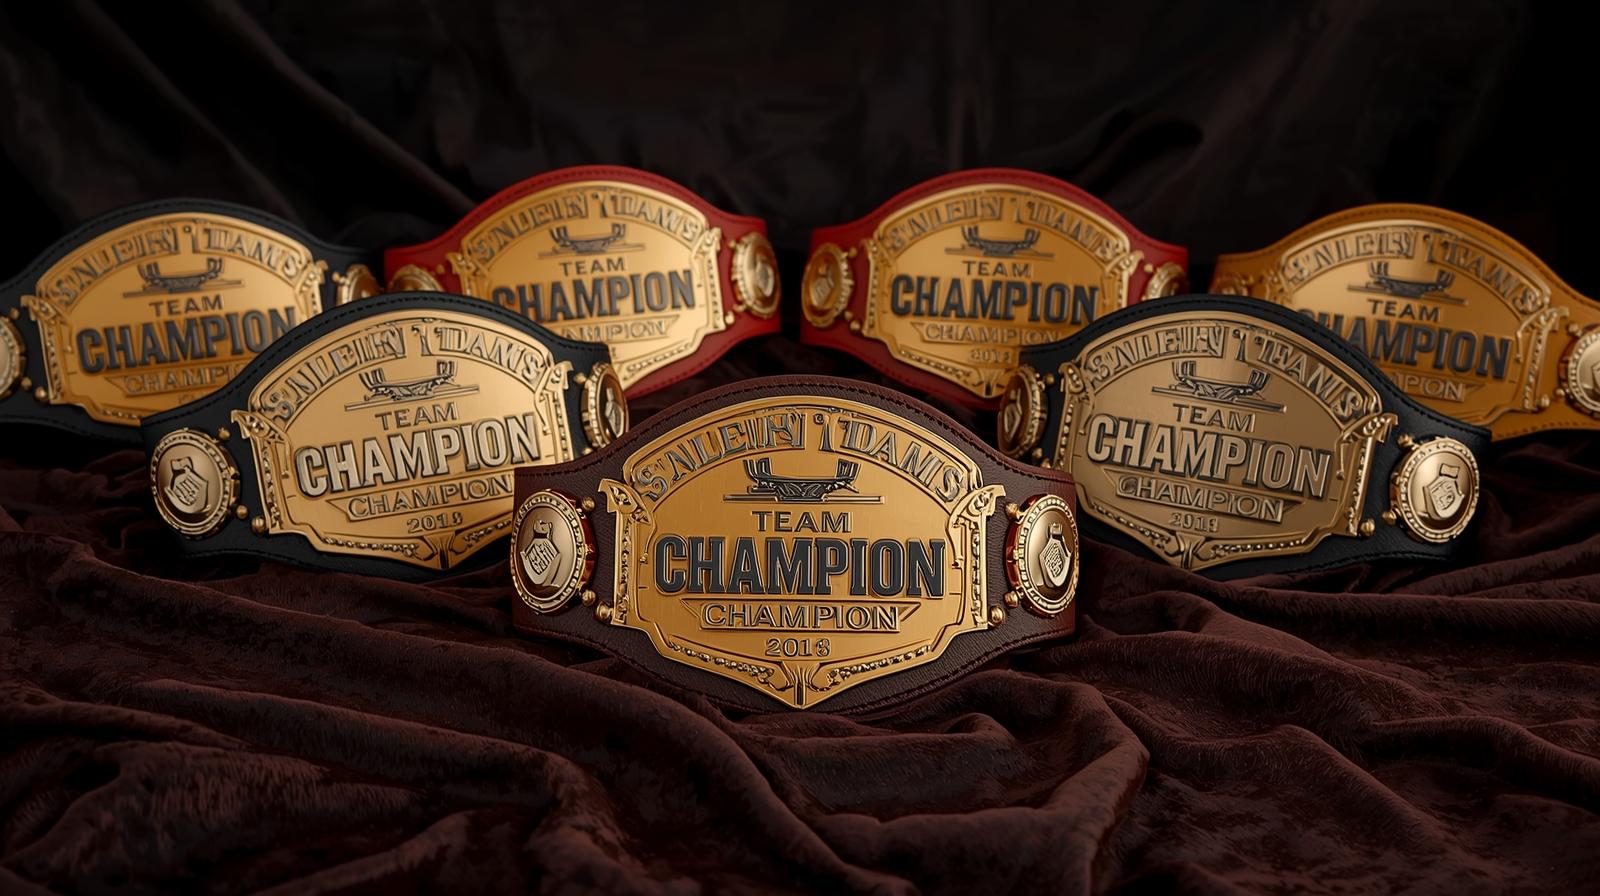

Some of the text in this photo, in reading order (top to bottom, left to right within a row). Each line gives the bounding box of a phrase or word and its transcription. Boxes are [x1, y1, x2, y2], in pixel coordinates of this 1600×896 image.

[559, 257, 625, 276] TEAM
[962, 260, 1031, 277] TEAM
[149, 294, 223, 317] TEAM
[890, 274, 1099, 326] CHAMPION
[1368, 299, 1440, 322] TEAM
[76, 306, 296, 374] CHAMPION
[124, 363, 248, 394] CHAMPI
[374, 402, 459, 430] TEAM
[1172, 403, 1256, 433] TEAM
[295, 413, 541, 498] CHAMPION
[1086, 415, 1334, 498] CHAMPION
[348, 474, 513, 518] CHAMPION
[1117, 474, 1284, 521] CHAMPION
[752, 511, 852, 533] TEAM
[654, 536, 946, 598] CHAMPION
[704, 604, 900, 631] CHAMPION
